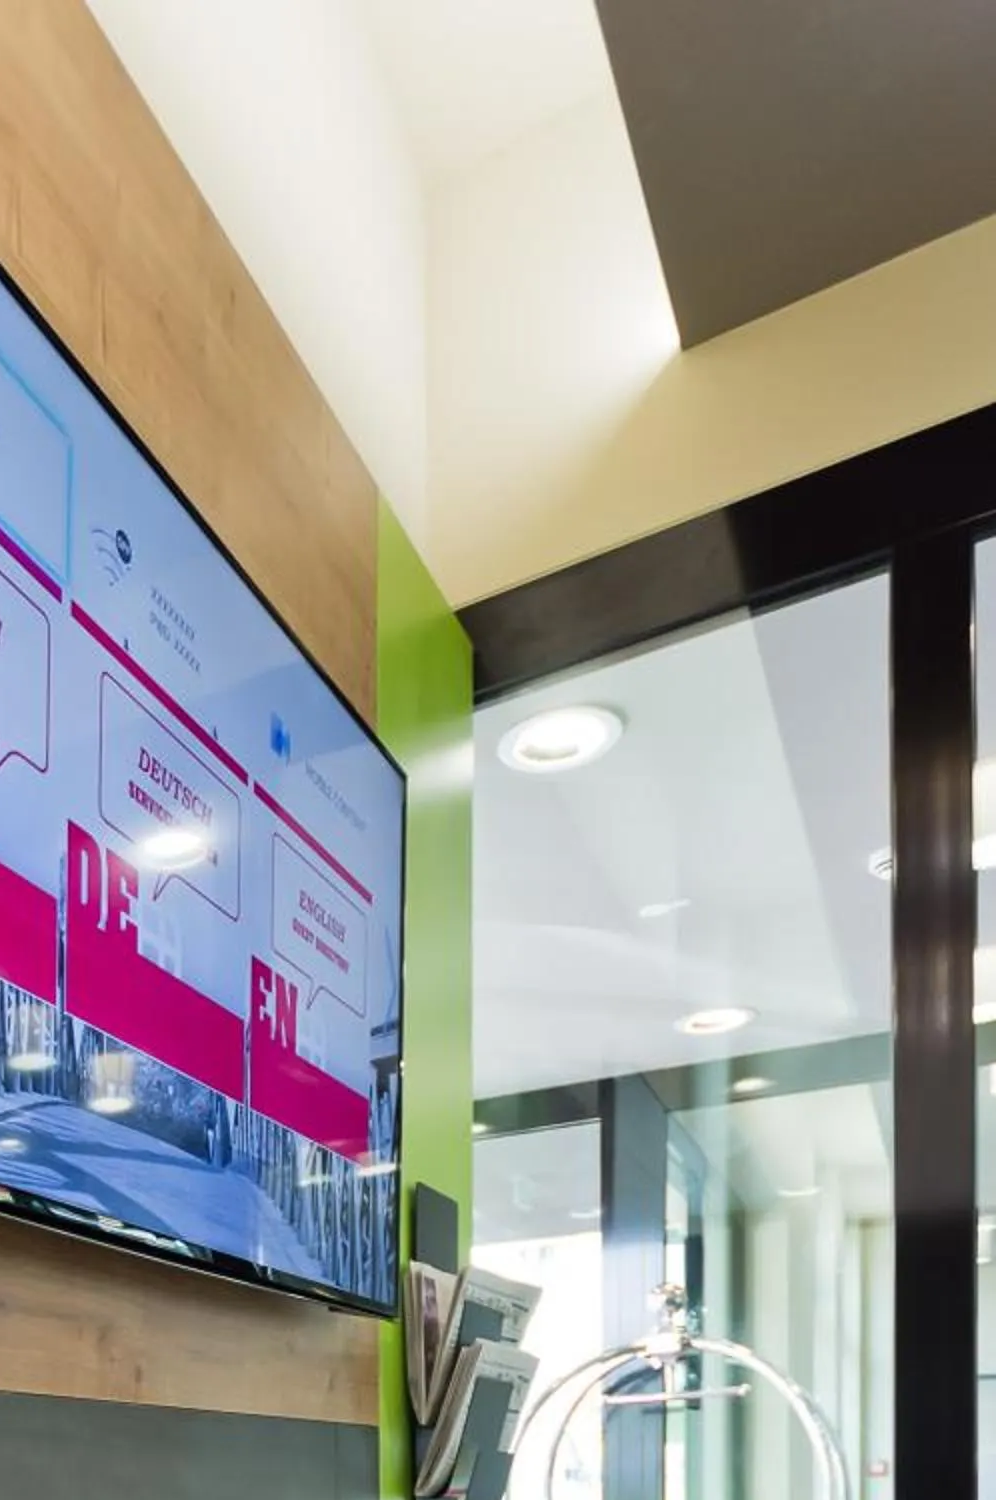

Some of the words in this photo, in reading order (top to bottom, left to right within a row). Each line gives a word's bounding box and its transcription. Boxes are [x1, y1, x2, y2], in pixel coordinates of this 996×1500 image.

[138, 747, 212, 827] DEUTSCH
[68, 820, 139, 952] DE
[300, 889, 346, 943] ENGLISH
[252, 956, 298, 1056] EN
